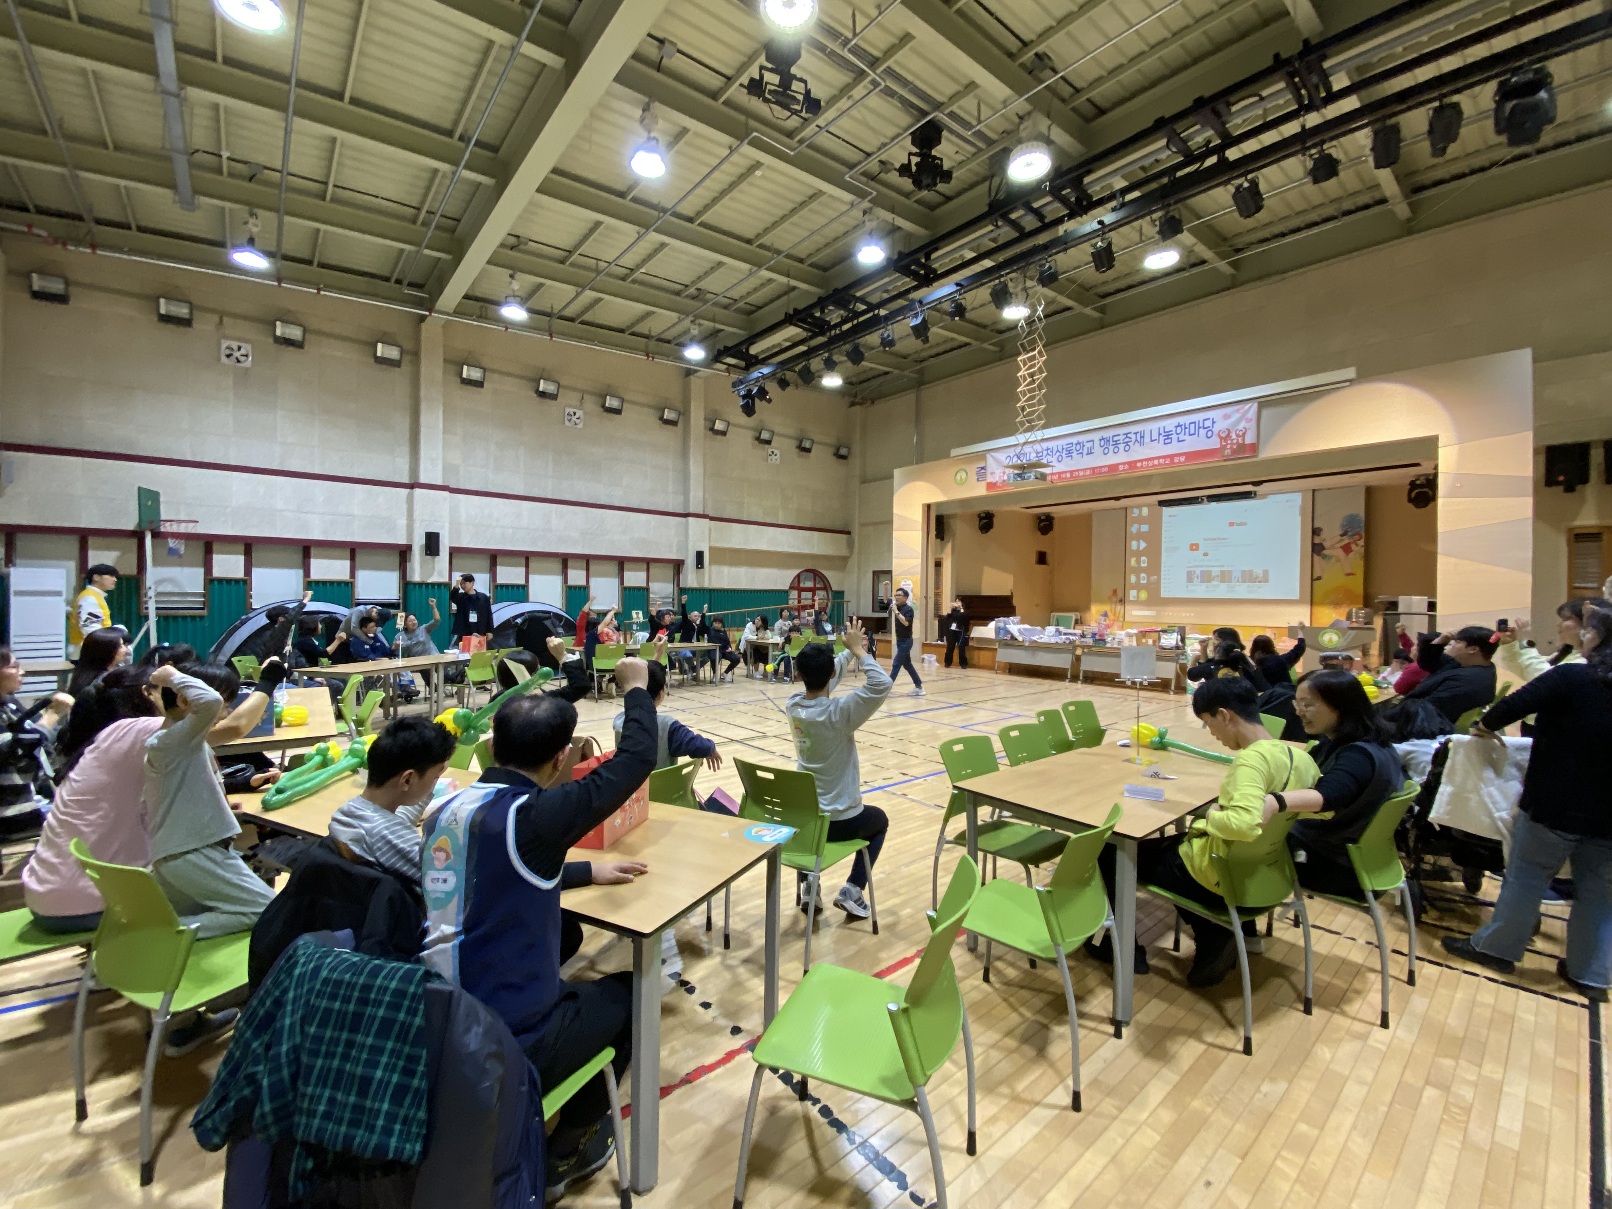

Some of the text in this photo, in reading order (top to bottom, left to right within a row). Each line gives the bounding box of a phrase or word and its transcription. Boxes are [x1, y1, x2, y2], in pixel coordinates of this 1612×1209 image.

[1035, 440, 1095, 463] 부천상록학교
[1099, 430, 1145, 455] 행동중재
[1149, 417, 1216, 445] 나눔한마당
